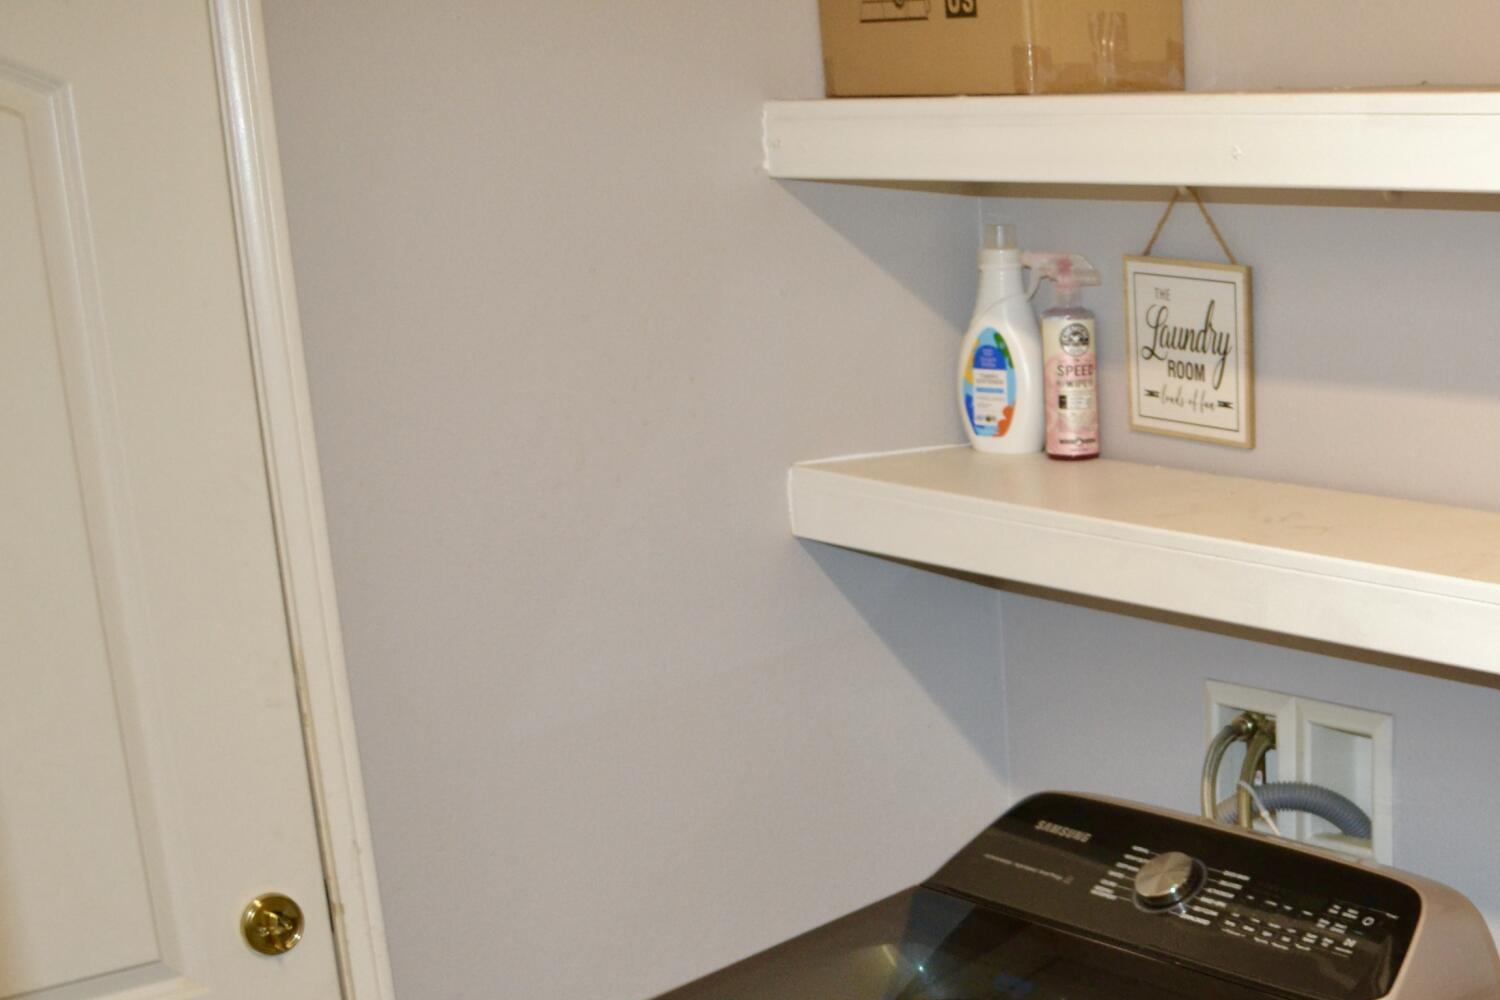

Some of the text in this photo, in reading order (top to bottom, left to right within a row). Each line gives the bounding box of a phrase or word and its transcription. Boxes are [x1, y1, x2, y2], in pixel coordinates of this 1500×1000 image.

[1154, 287, 1171, 301] THE
[1141, 299, 1233, 391] Laundry
[1167, 359, 1206, 382] ROOM
[1034, 819, 1093, 844] SAMSUNG
